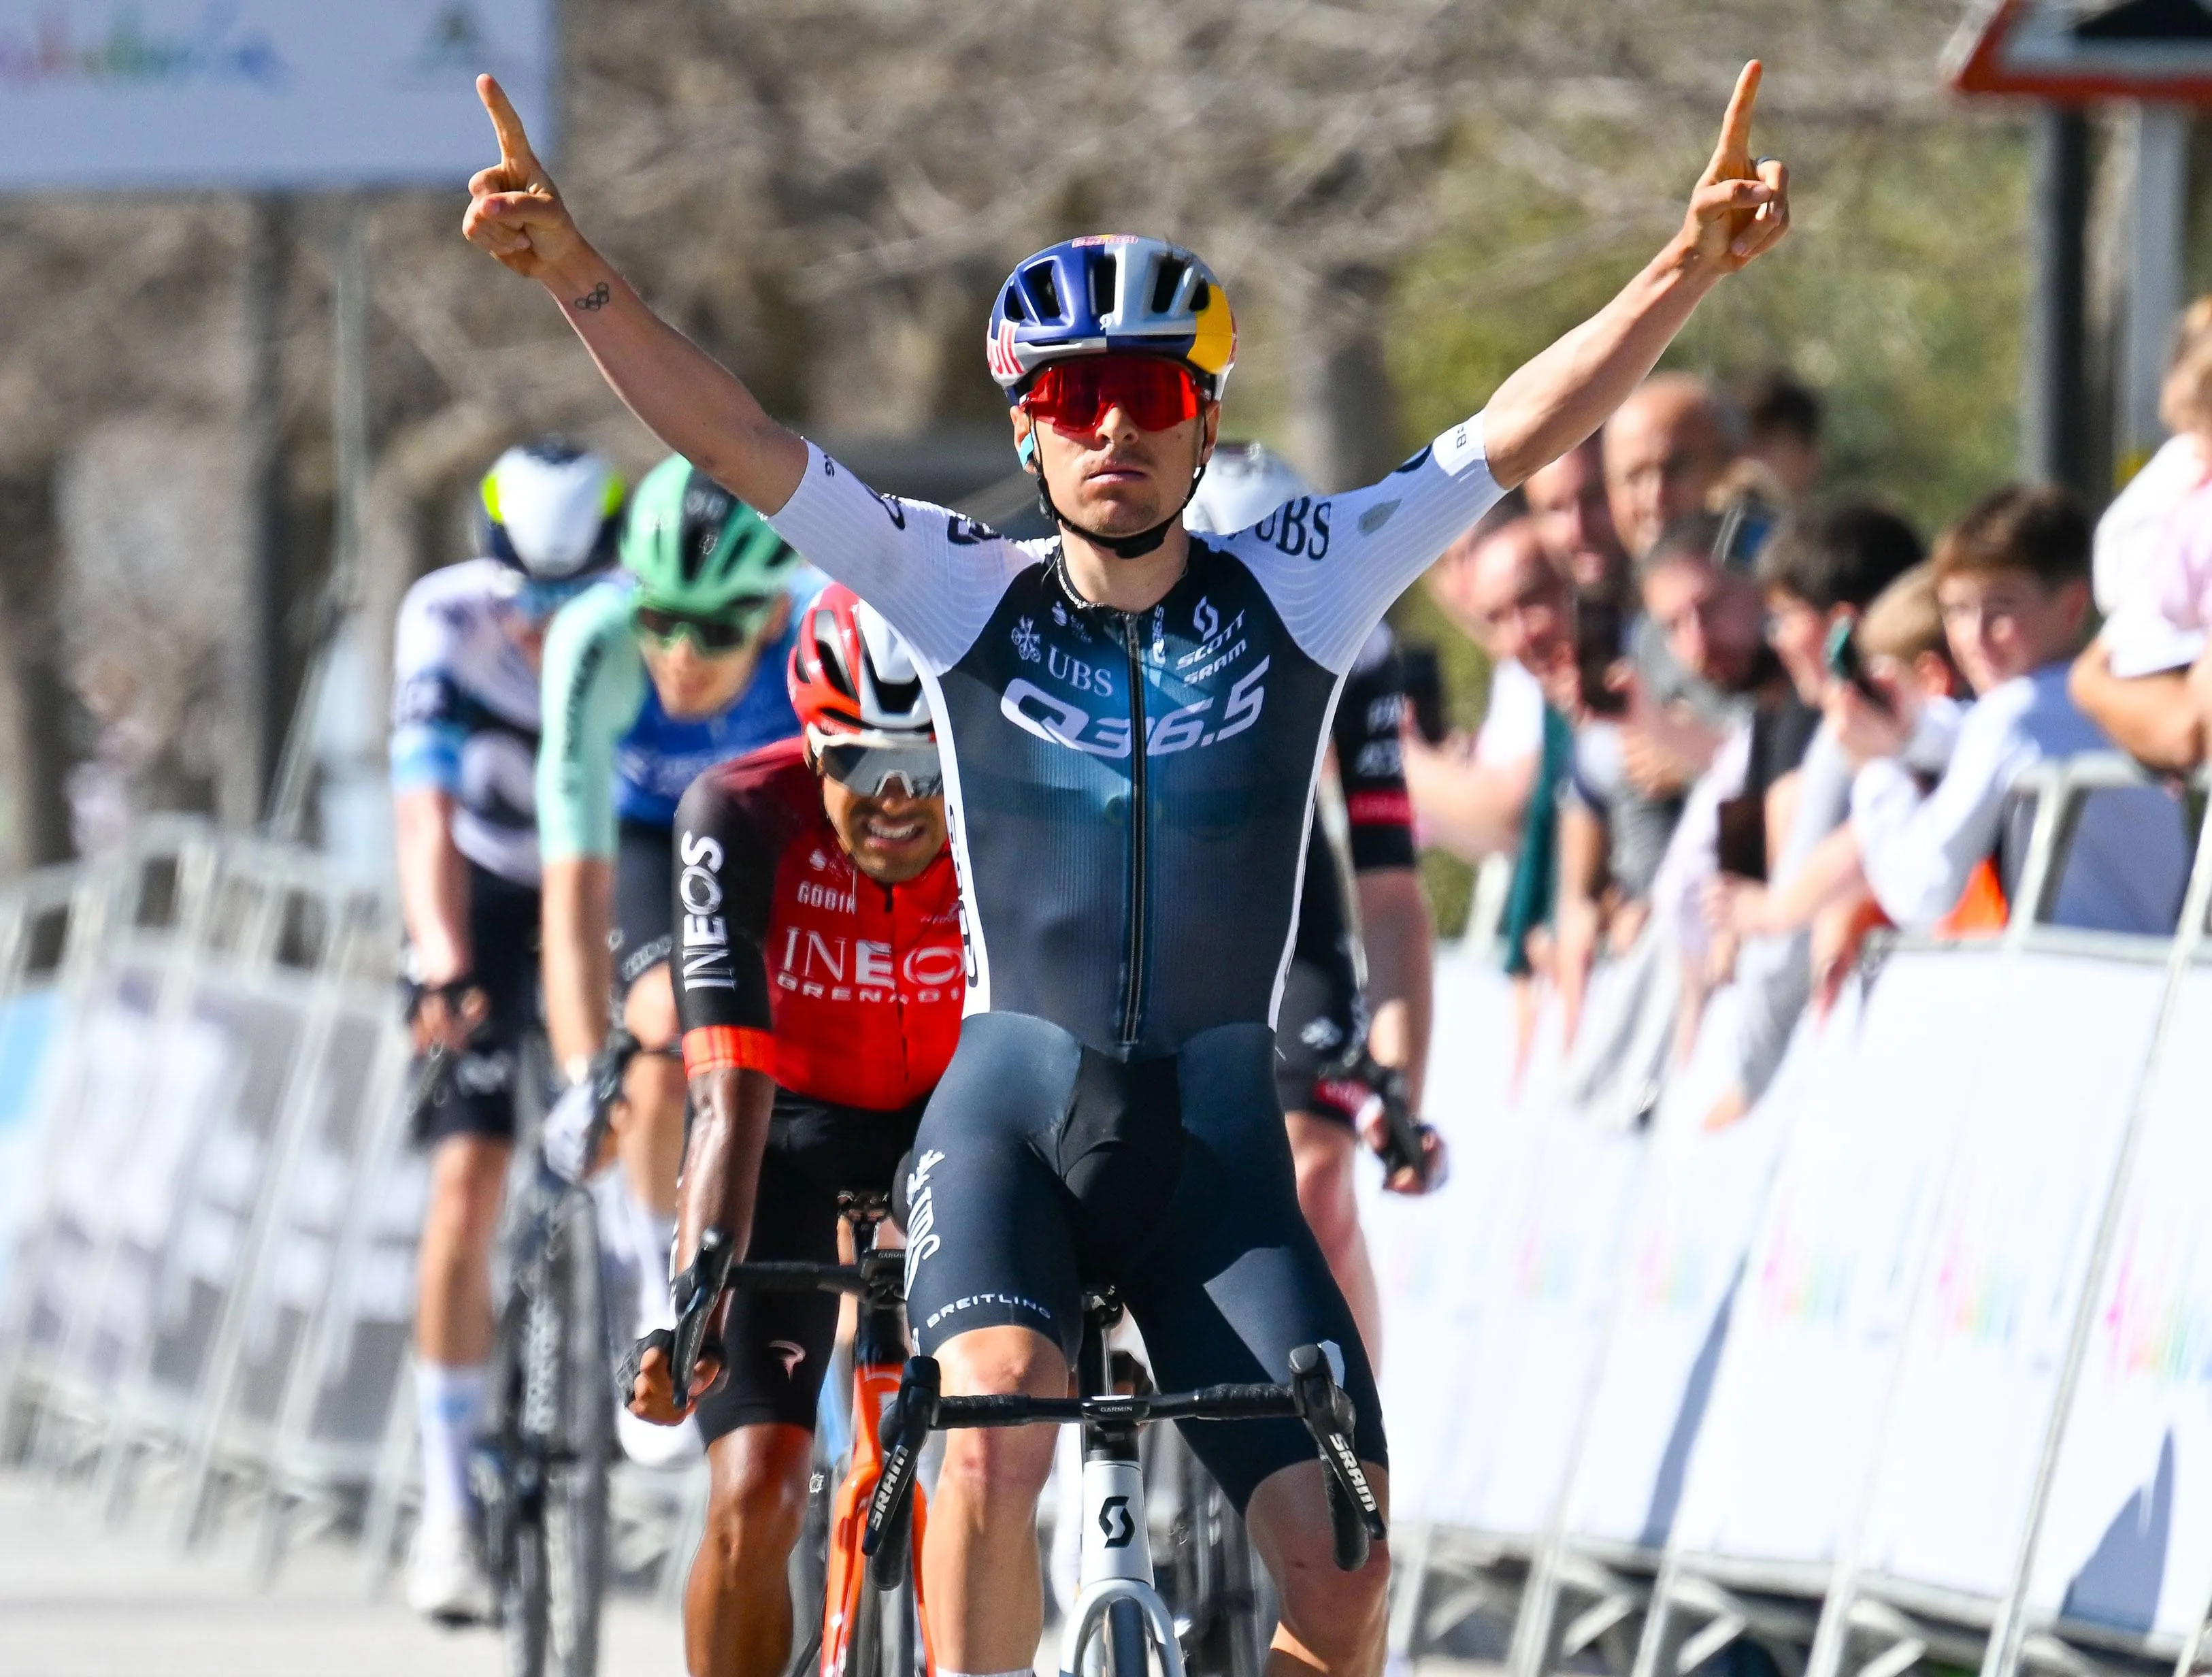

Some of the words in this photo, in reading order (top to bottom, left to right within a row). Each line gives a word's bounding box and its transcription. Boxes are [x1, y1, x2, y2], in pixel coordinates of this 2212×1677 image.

[1176, 608, 1246, 670] SCOTT
[1183, 638, 1247, 688] SRAM
[1048, 644, 1114, 698] UBS
[1000, 654, 1270, 759] Q36.5
[680, 830, 737, 993] INEOS
[776, 971, 961, 1004] GRENADI
[779, 926, 965, 991] INEO
[926, 1293, 1051, 1329] BREITLING
[868, 1444, 909, 1531] SRAM
[1329, 1432, 1377, 1512] SRAM
